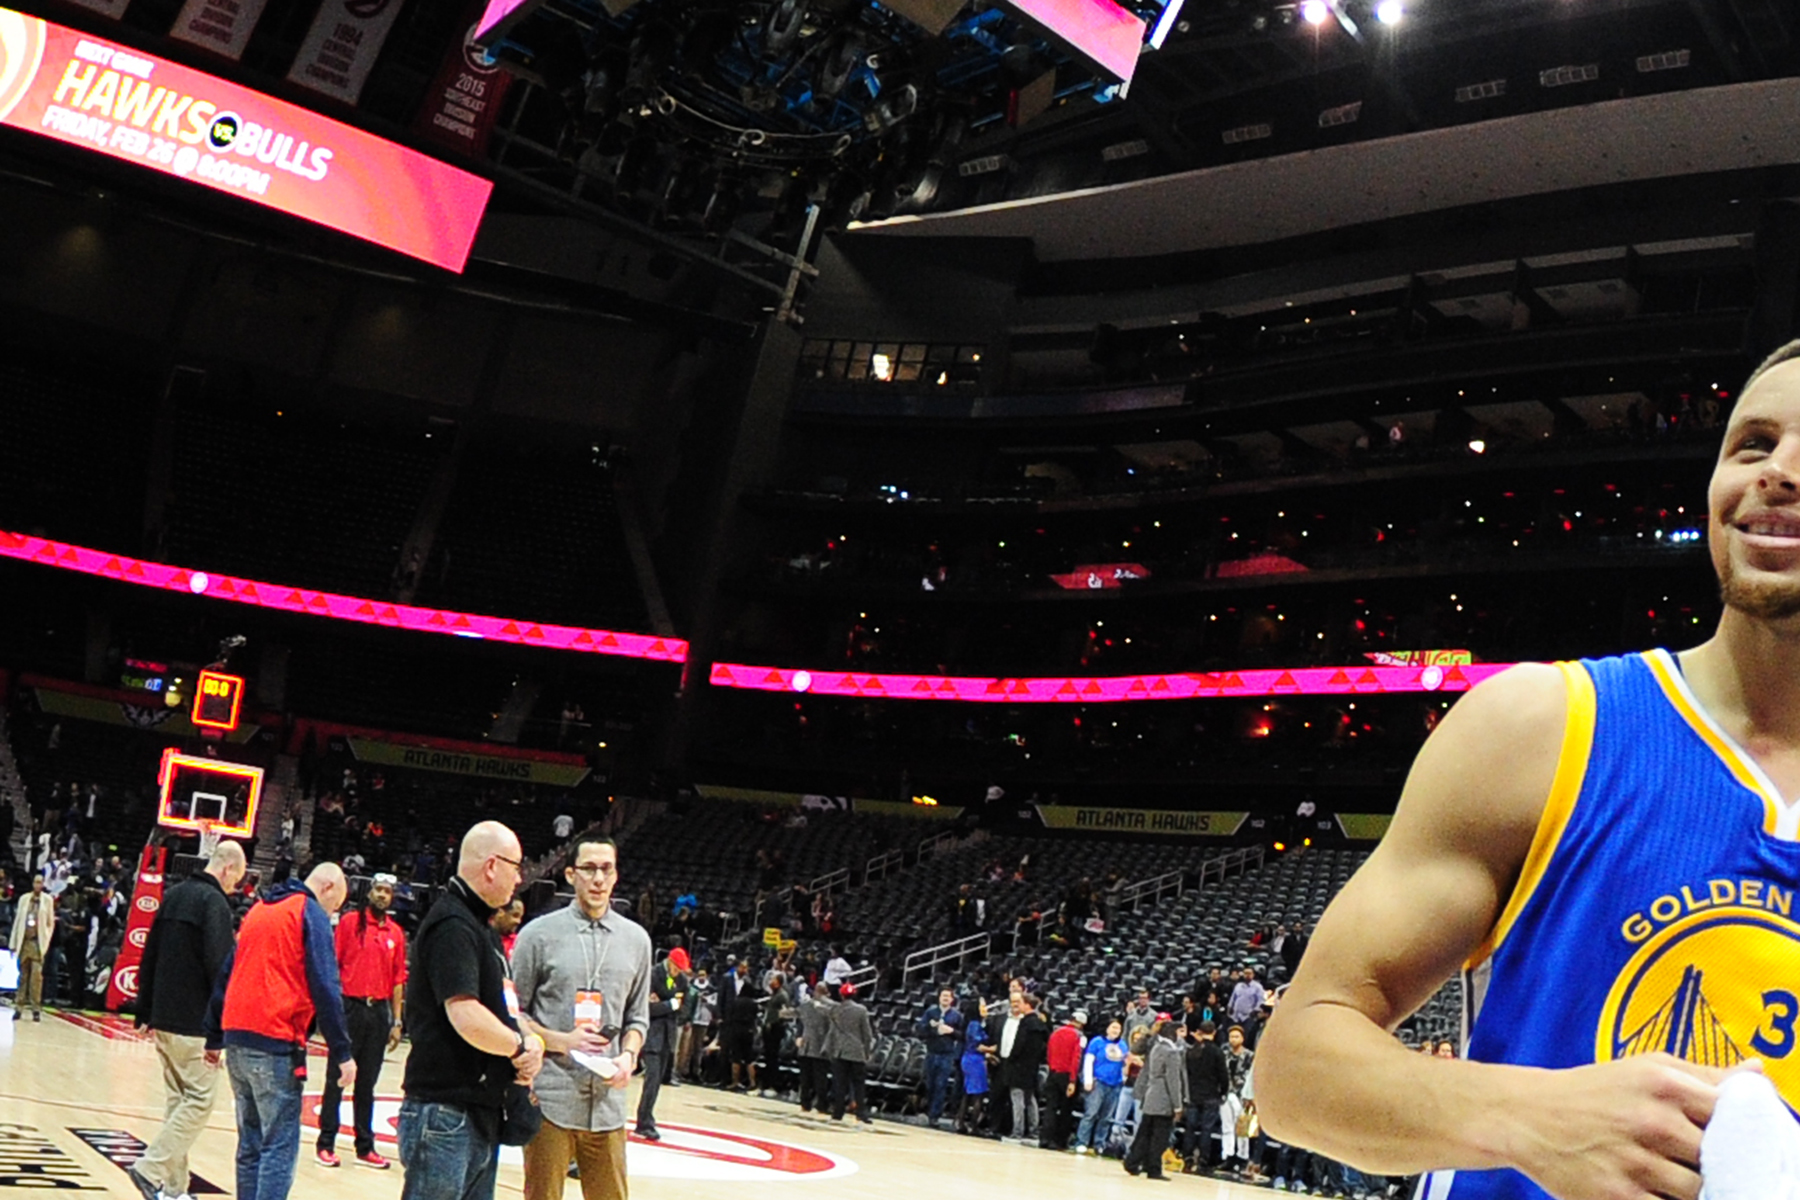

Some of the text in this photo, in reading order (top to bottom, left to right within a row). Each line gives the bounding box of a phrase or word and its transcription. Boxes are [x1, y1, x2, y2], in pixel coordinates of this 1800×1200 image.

[455, 73, 486, 97] 2015
[53, 59, 215, 143] HAWKS
[237, 122, 332, 180] BULLS
[110, 126, 150, 155] FEB
[147, 138, 176, 163] 26
[404, 749, 531, 777] ATLANTA HAWKS
[1075, 810, 1210, 832] ATLANTA HAWKS
[1621, 879, 1793, 942] GOLDEN
